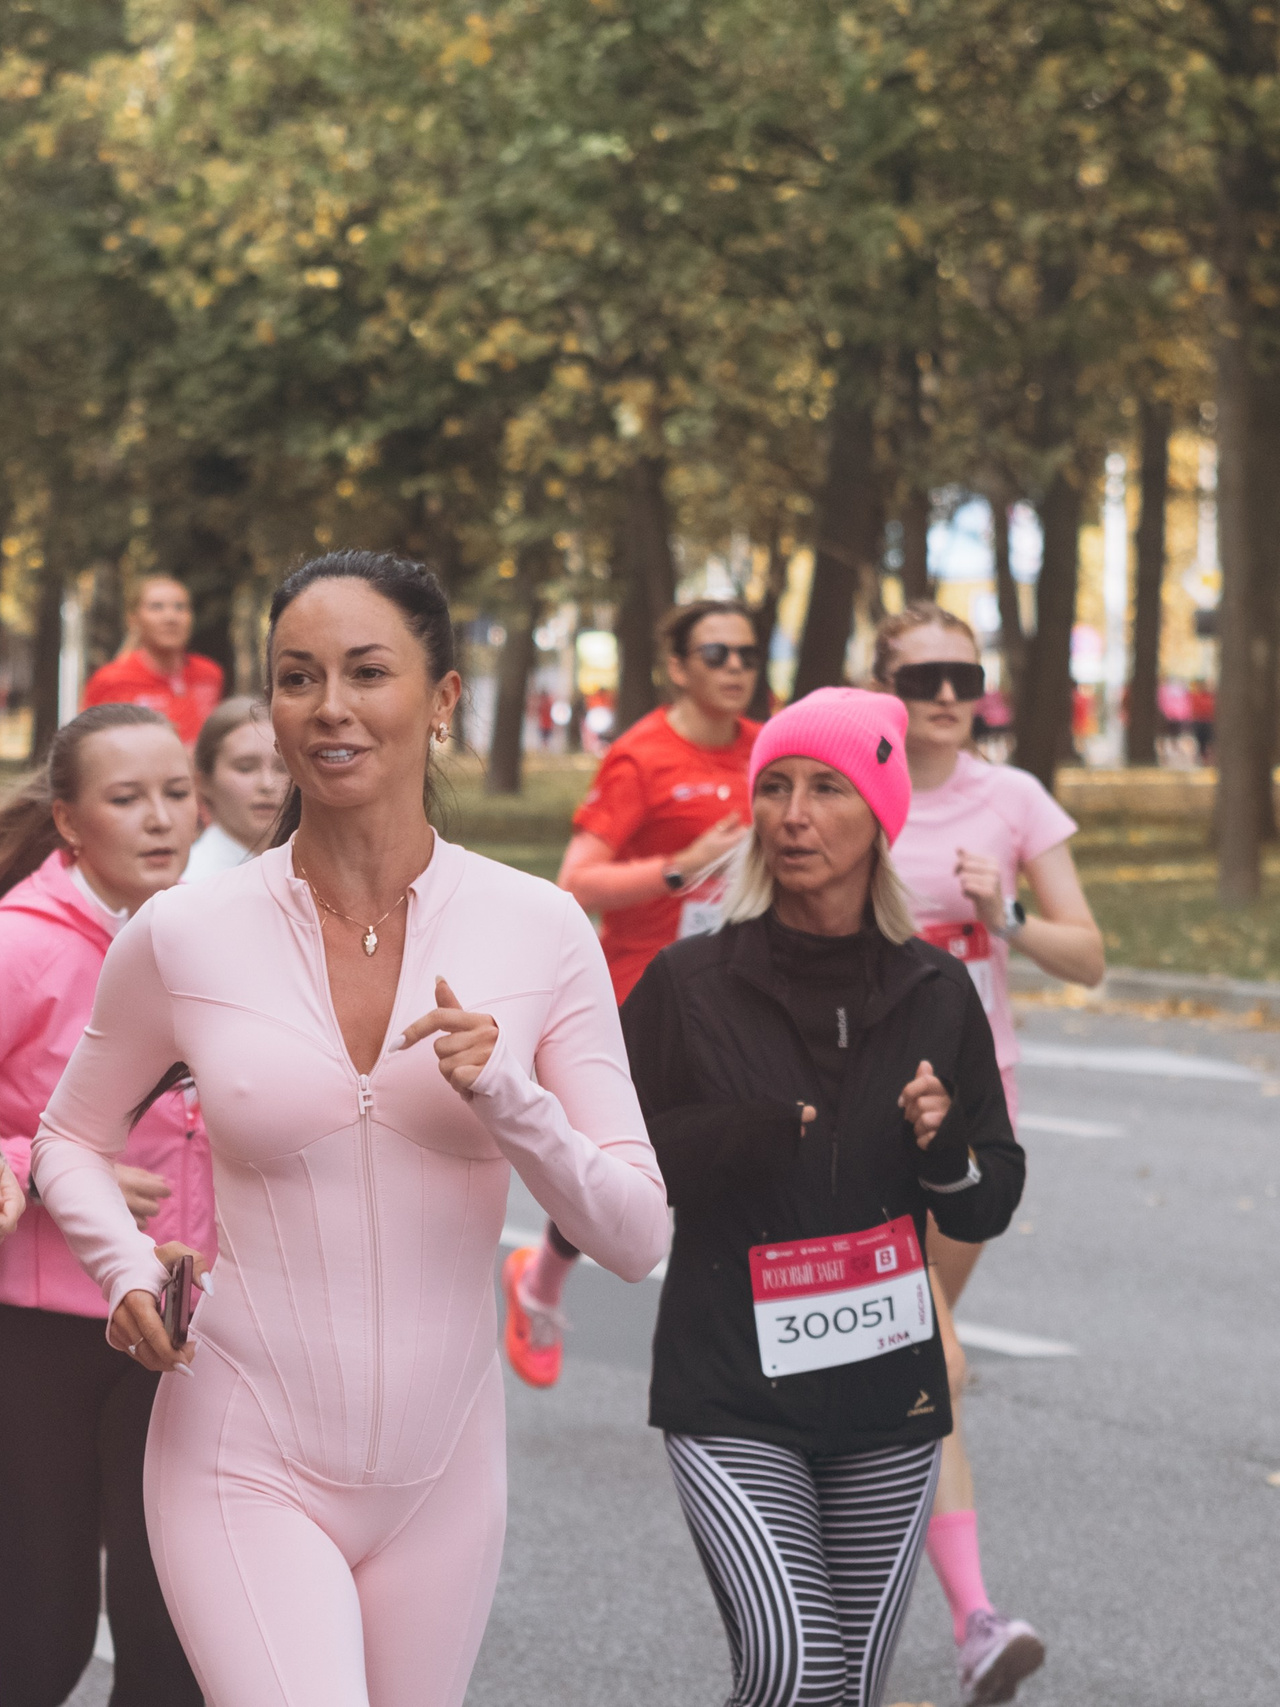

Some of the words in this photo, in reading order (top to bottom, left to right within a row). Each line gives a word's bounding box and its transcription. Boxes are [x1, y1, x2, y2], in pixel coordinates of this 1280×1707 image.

[836, 1007, 848, 1048] Reebok
[762, 1262, 815, 1290] РОЗОВЫЙ
[816, 1259, 845, 1283] ЗАБЕГ
[775, 1296, 895, 1344] 30051
[877, 1337, 885, 1350] 3
